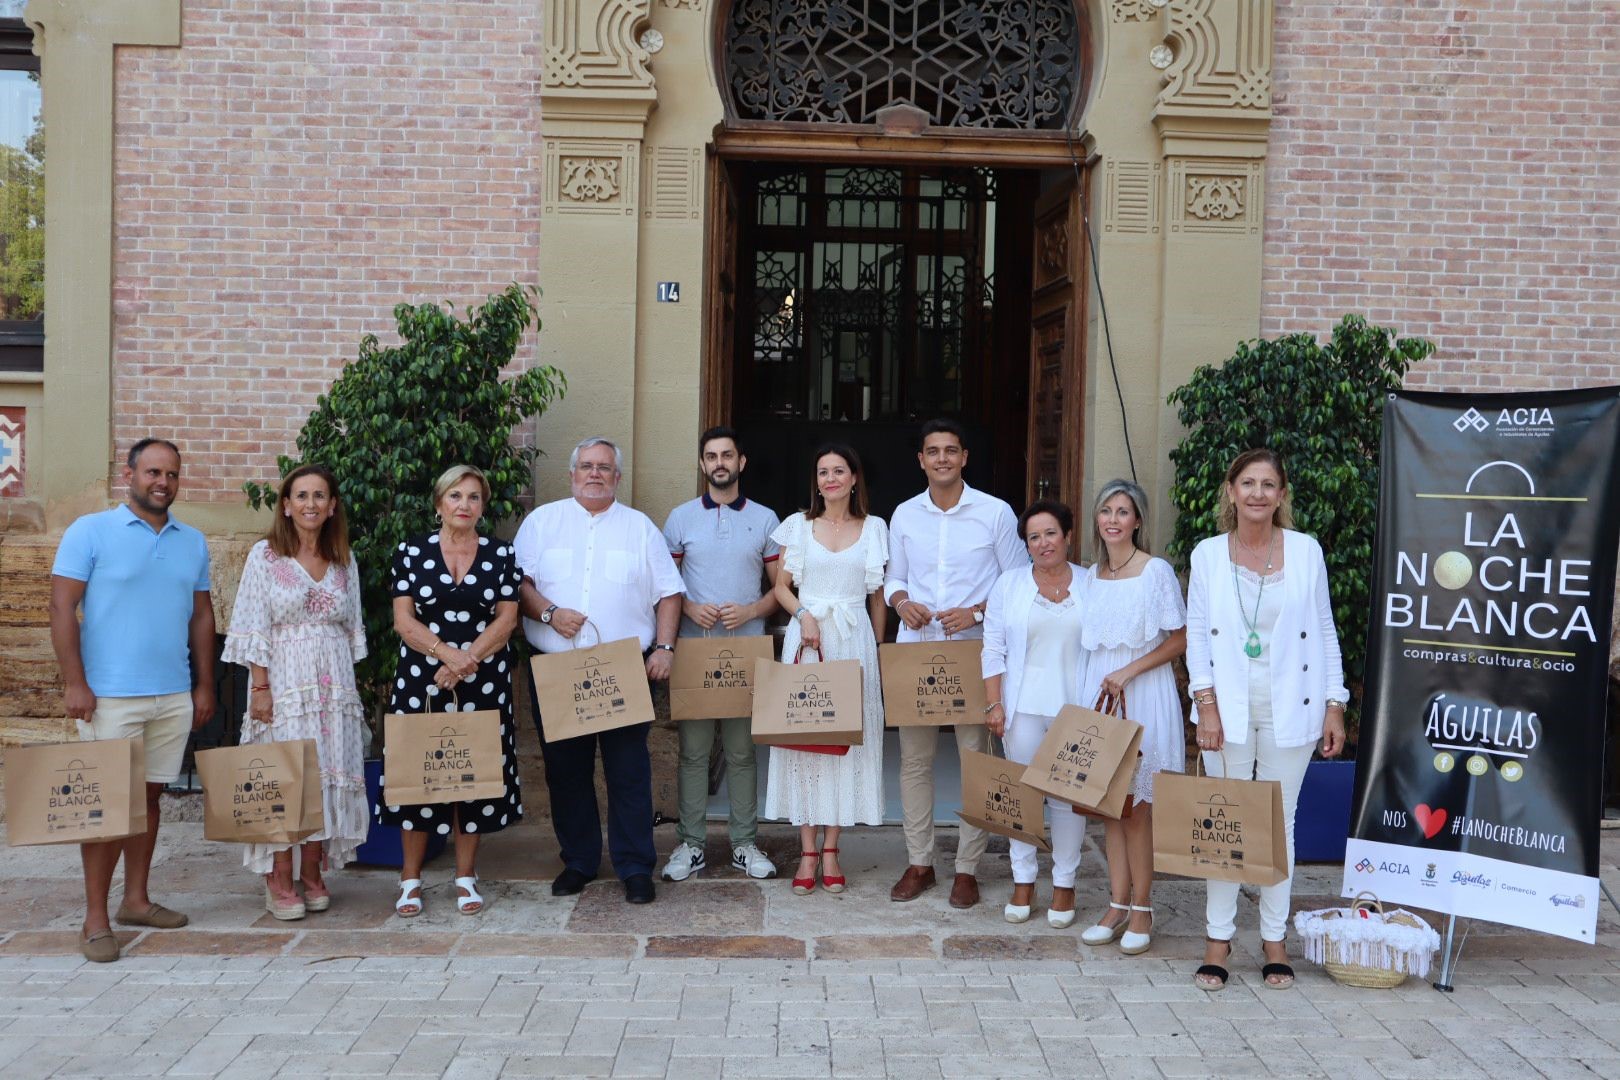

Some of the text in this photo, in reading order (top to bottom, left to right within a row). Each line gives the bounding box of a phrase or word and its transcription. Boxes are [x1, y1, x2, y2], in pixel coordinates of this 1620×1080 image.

[659, 283, 679, 301] 14
[1496, 407, 1554, 425] ACIA
[1464, 511, 1525, 548] LA
[1396, 551, 1592, 596] NOCHE
[1385, 592, 1597, 643] BLANCA
[719, 661, 732, 670] LA
[1403, 648, 1575, 673] compras&cultura&ocio
[586, 668, 601, 679] LA
[705, 670, 746, 680] NOCHE
[932, 666, 946, 675] LA
[573, 675, 617, 692] NOCHE
[918, 676, 961, 686] NOCHE
[574, 685, 621, 702] BLANCA
[803, 684, 818, 692] LA
[917, 686, 963, 696] BLANCA
[789, 691, 832, 700] NOCHE
[787, 700, 834, 709] BLANCA
[1425, 693, 1538, 750] ÁGUILAS
[440, 739, 455, 749] LA
[1080, 736, 1092, 747] LA
[425, 749, 470, 760] NOCHE
[1064, 741, 1098, 760] NOCHE
[424, 760, 473, 771] BLANCA
[1056, 750, 1092, 769] BLANCA
[68, 773, 84, 784] LA
[249, 771, 263, 781] LA
[51, 783, 100, 795] NOCHE
[235, 781, 279, 792] NOCHE
[998, 785, 1010, 795] LA
[49, 794, 101, 808] BLANCA
[233, 791, 282, 804] BLANCA
[987, 790, 1020, 809] NOCHE
[985, 800, 1022, 819] BLANCA
[1209, 807, 1226, 819] LA
[1193, 818, 1242, 833] NOCHE
[1383, 809, 1407, 829] NOS
[1192, 829, 1243, 846] BLANCA
[1379, 861, 1410, 875] ACIA
[1501, 883, 1537, 896] Comercio
